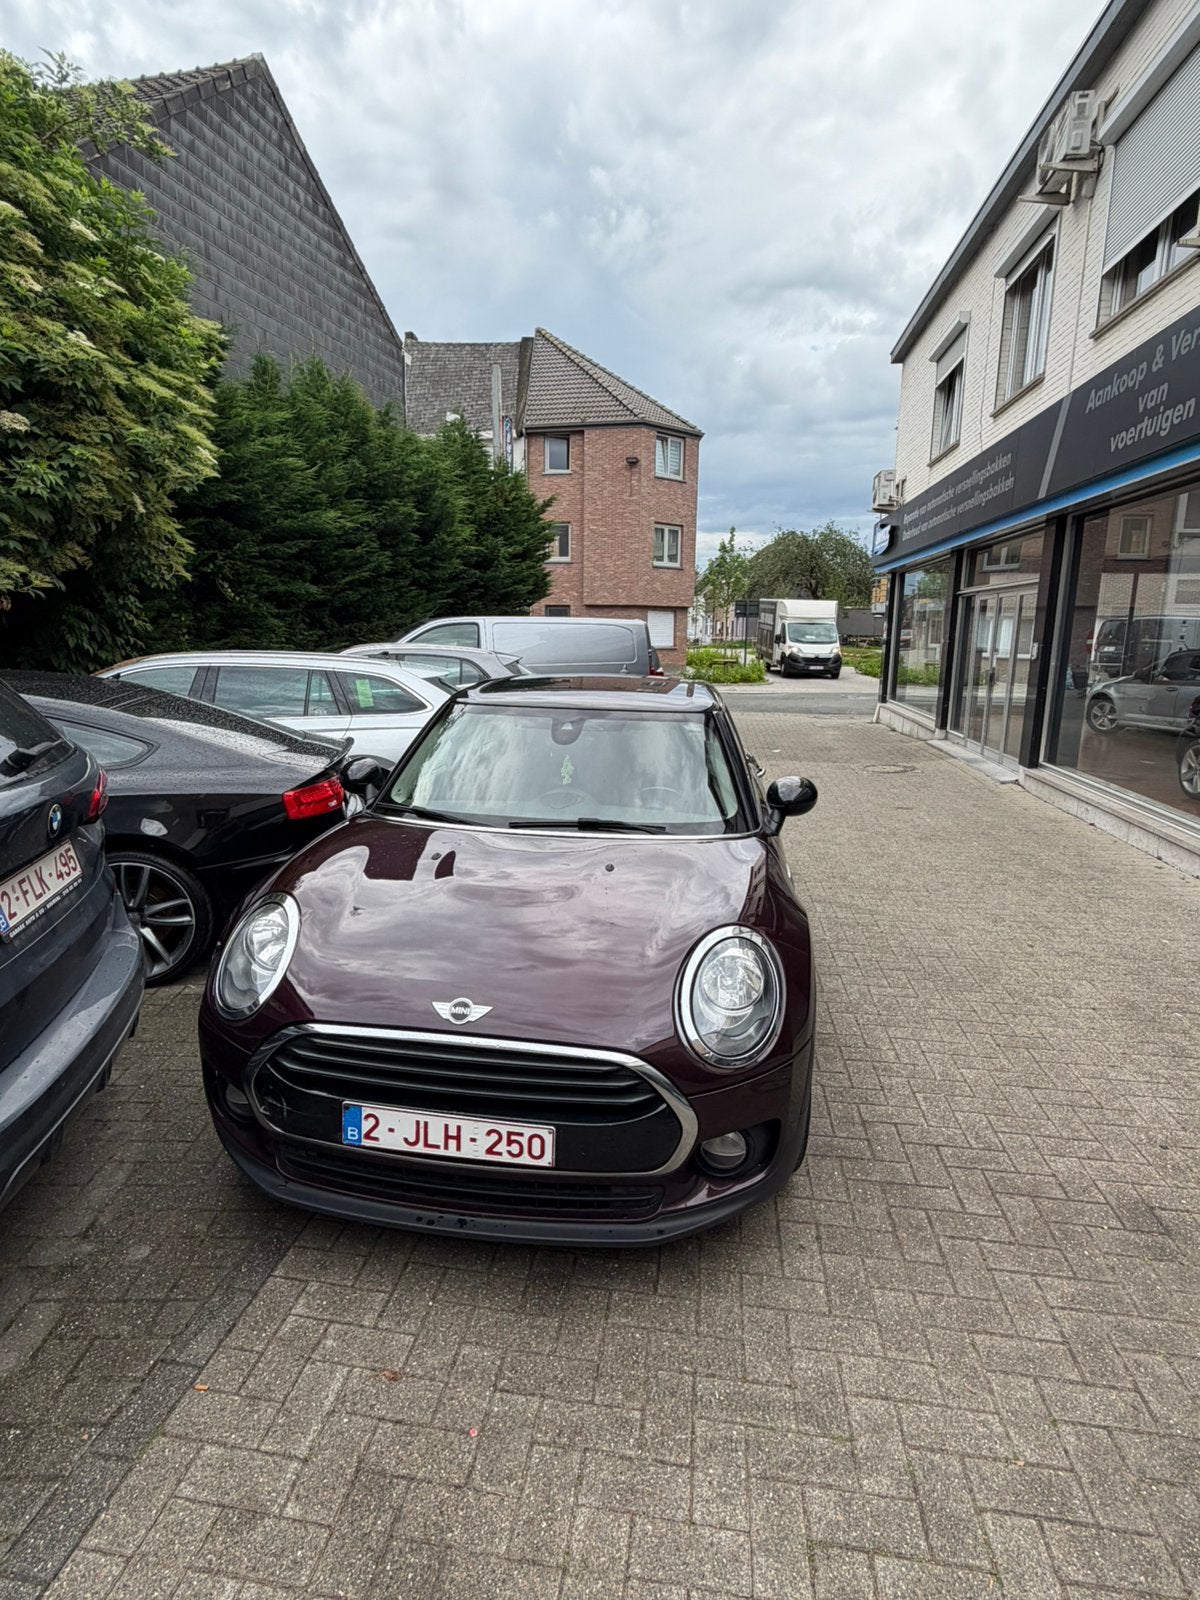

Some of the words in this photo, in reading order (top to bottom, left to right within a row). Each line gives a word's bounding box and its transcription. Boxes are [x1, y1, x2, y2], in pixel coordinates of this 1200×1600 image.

[1085, 361, 1147, 414] Aankoop
[1152, 344, 1165, 372] &
[1138, 382, 1169, 413] van
[1110, 397, 1196, 453] voertuigen
[451, 1006, 470, 1015] MINI
[346, 1127, 359, 1140] B
